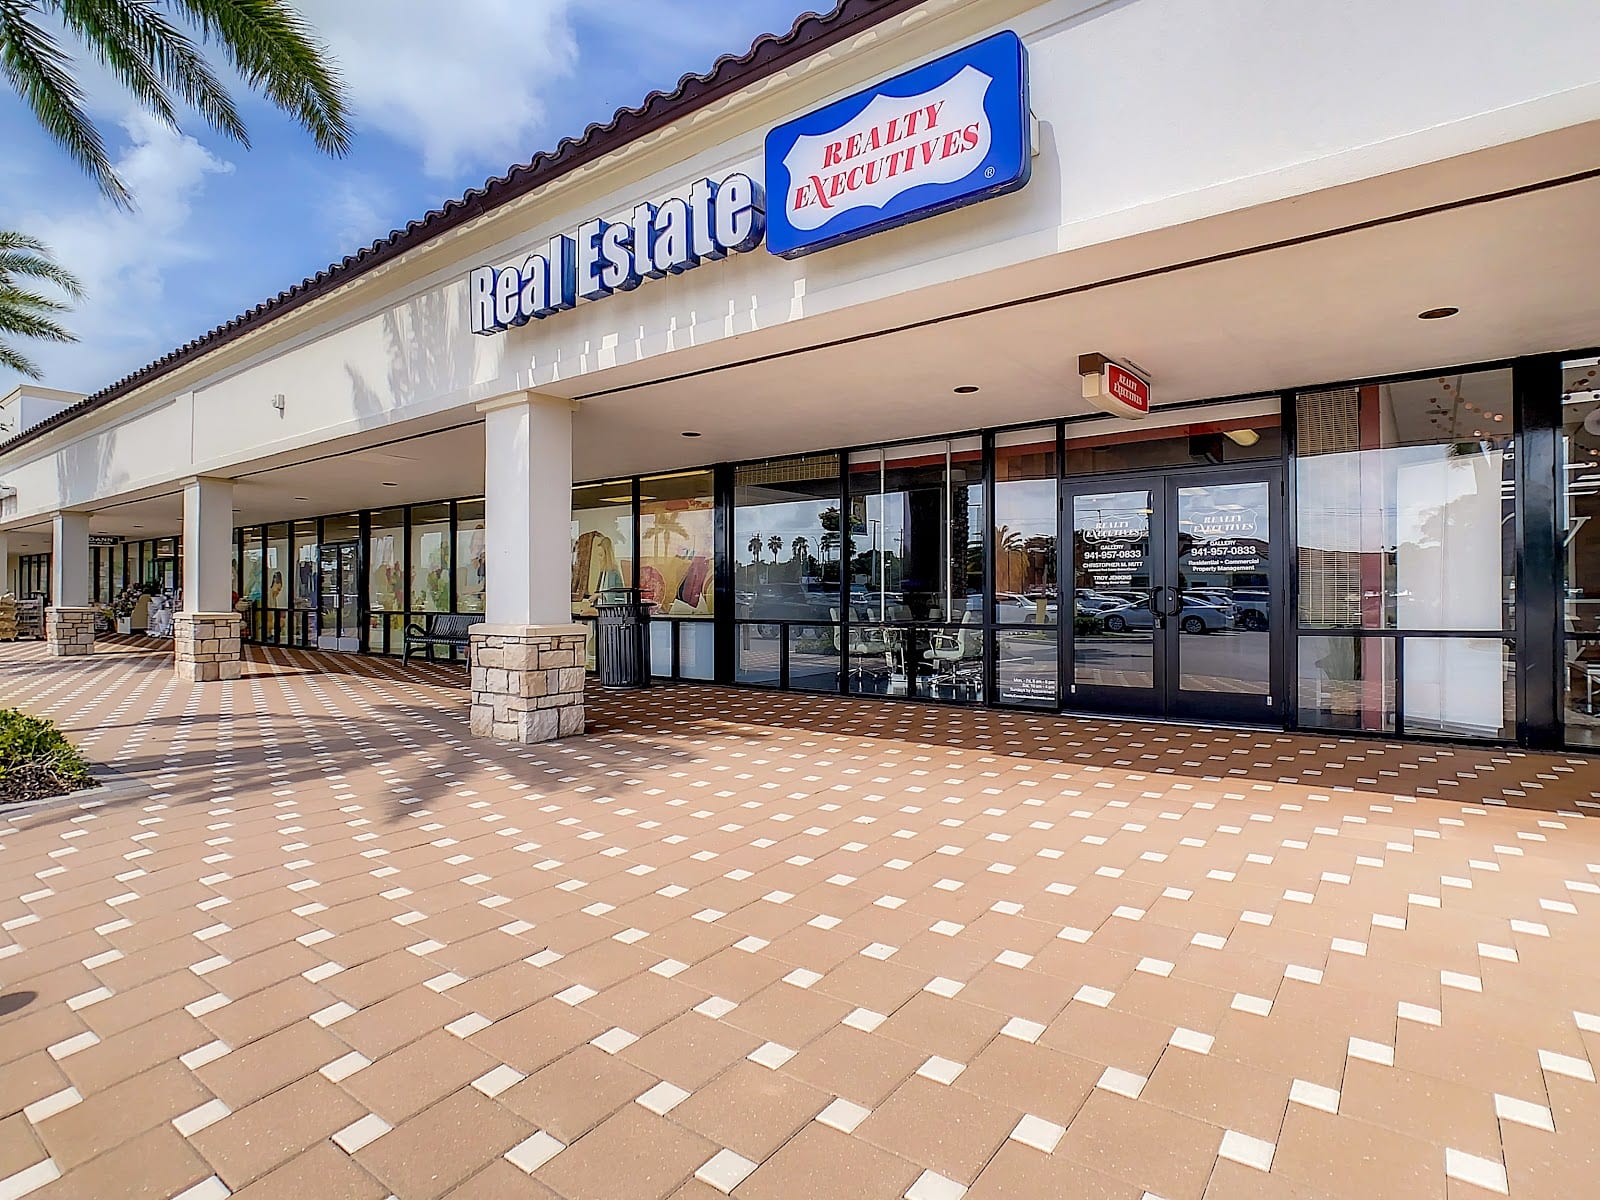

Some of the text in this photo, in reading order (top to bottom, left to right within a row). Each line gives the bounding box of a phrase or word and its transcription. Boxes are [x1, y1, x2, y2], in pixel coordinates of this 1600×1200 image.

[821, 100, 946, 170] REALTY
[792, 122, 981, 212] EXECUTIVES
[470, 172, 765, 335] Real Estate
[1204, 514, 1242, 524] REALTY
[1193, 523, 1254, 535] EXECUTIVES
[1083, 549, 1142, 560] 941-957-0833
[1190, 545, 1257, 557] 941-957-0833
